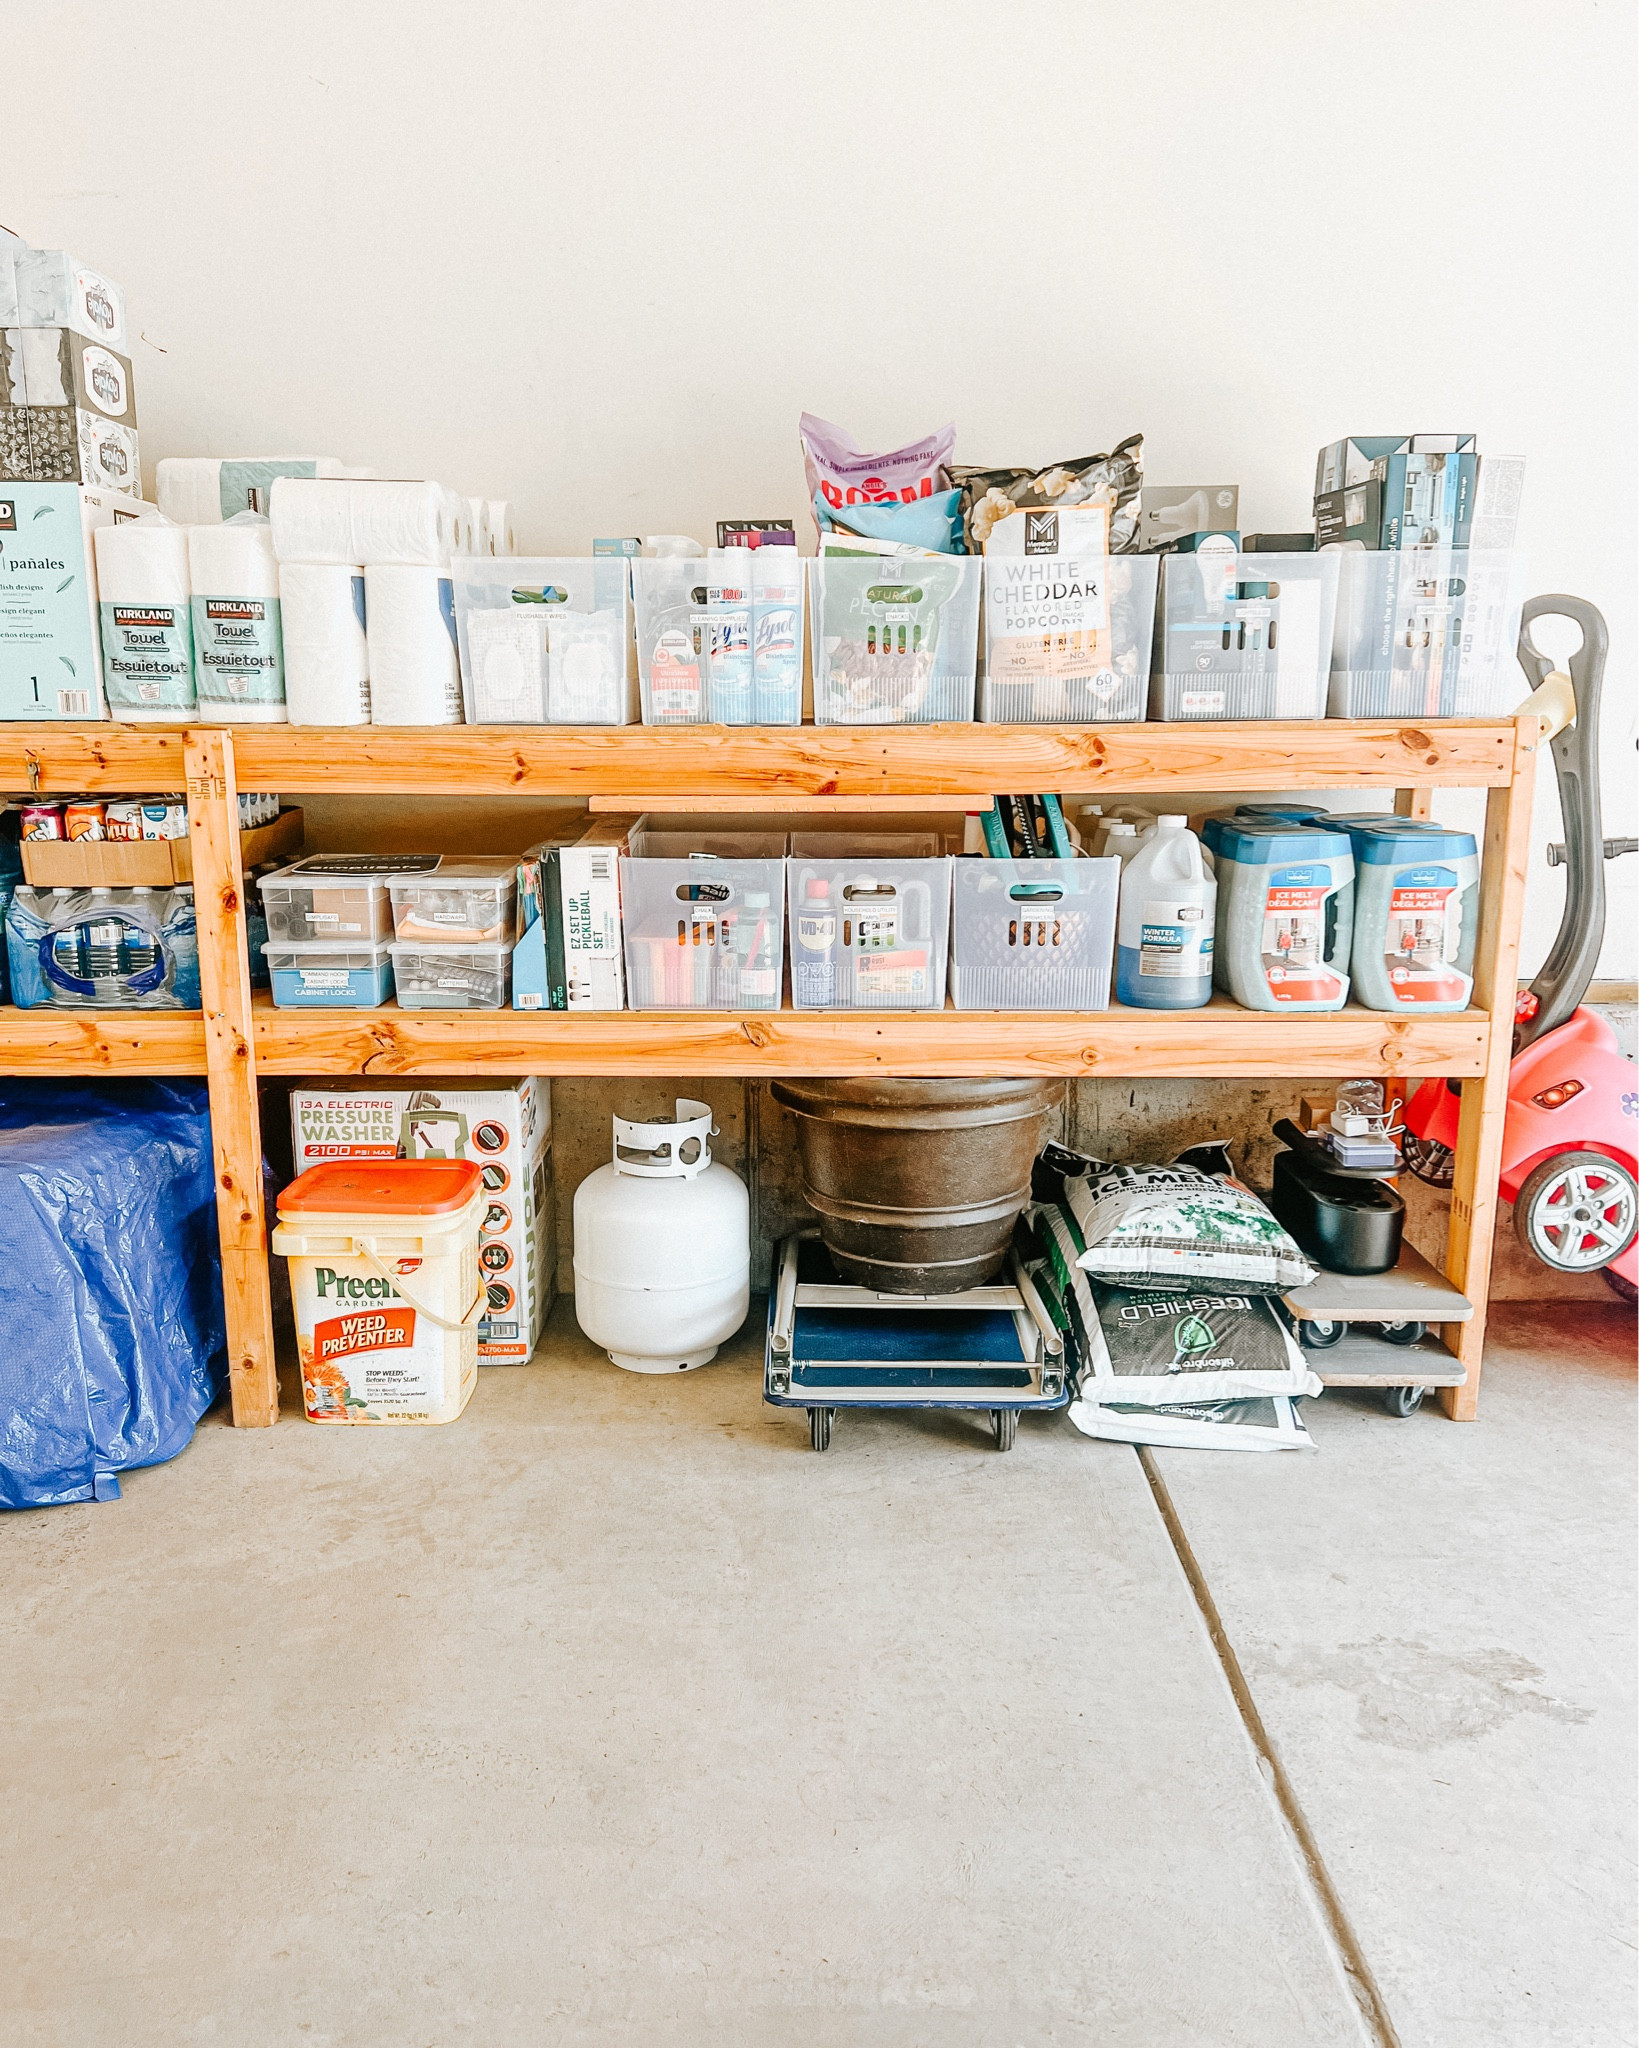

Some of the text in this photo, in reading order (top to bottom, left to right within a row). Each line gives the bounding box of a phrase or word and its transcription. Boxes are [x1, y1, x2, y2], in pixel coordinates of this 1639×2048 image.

[919, 451, 934, 461] FAKE
[1390, 517, 1399, 542] white
[10, 558, 65, 571] pañales
[1387, 558, 1396, 583] shade
[1006, 562, 1079, 582] WHITE
[993, 581, 1098, 604] CHEDDAR
[1384, 584, 1394, 606] right
[116, 609, 172, 620] KIRKLAND
[207, 602, 264, 613] KIRKLAND
[849, 597, 919, 621] PECAN
[1006, 601, 1082, 615] FLAVORED
[1384, 606, 1392, 627] the
[214, 623, 256, 637] Towel
[755, 612, 796, 645] Lysol
[123, 631, 167, 644] Towel
[1380, 629, 1389, 656] choose
[1016, 640, 1051, 650] GLUTEN
[203, 651, 276, 667] Essuietout
[1011, 657, 1027, 665] NO
[1069, 651, 1086, 660] NO
[111, 658, 188, 674] Essuietout
[1096, 673, 1113, 687] 60
[30, 676, 39, 702] 1
[1276, 891, 1313, 899] ICE MELT
[1400, 892, 1438, 900] ICE MELT
[1268, 898, 1319, 908] DÉGLAÇANT
[1392, 899, 1445, 909] DÉGLAÇANT
[569, 897, 581, 950] EZ SET UP
[580, 889, 592, 949] PICKLEBALL
[800, 920, 834, 936] WD-40
[1143, 928, 1175, 936] WINTER
[594, 931, 604, 950] SET
[1143, 935, 1182, 943] FORMULA
[327, 1101, 393, 1109] ELECTRIC
[300, 1110, 394, 1124] PRESSURE
[301, 1126, 395, 1141] WASHER
[308, 1146, 351, 1156] 2100
[1091, 1177, 1137, 1201] ICE
[1148, 1174, 1223, 1187] MELT
[1186, 1188, 1244, 1199] SIDEWALKS
[314, 1267, 402, 1299] Preen
[336, 1300, 384, 1308] GARDEN
[1118, 1296, 1253, 1320] ICESHIELD
[340, 1315, 387, 1336] WEED
[321, 1328, 405, 1357] PREVENTER
